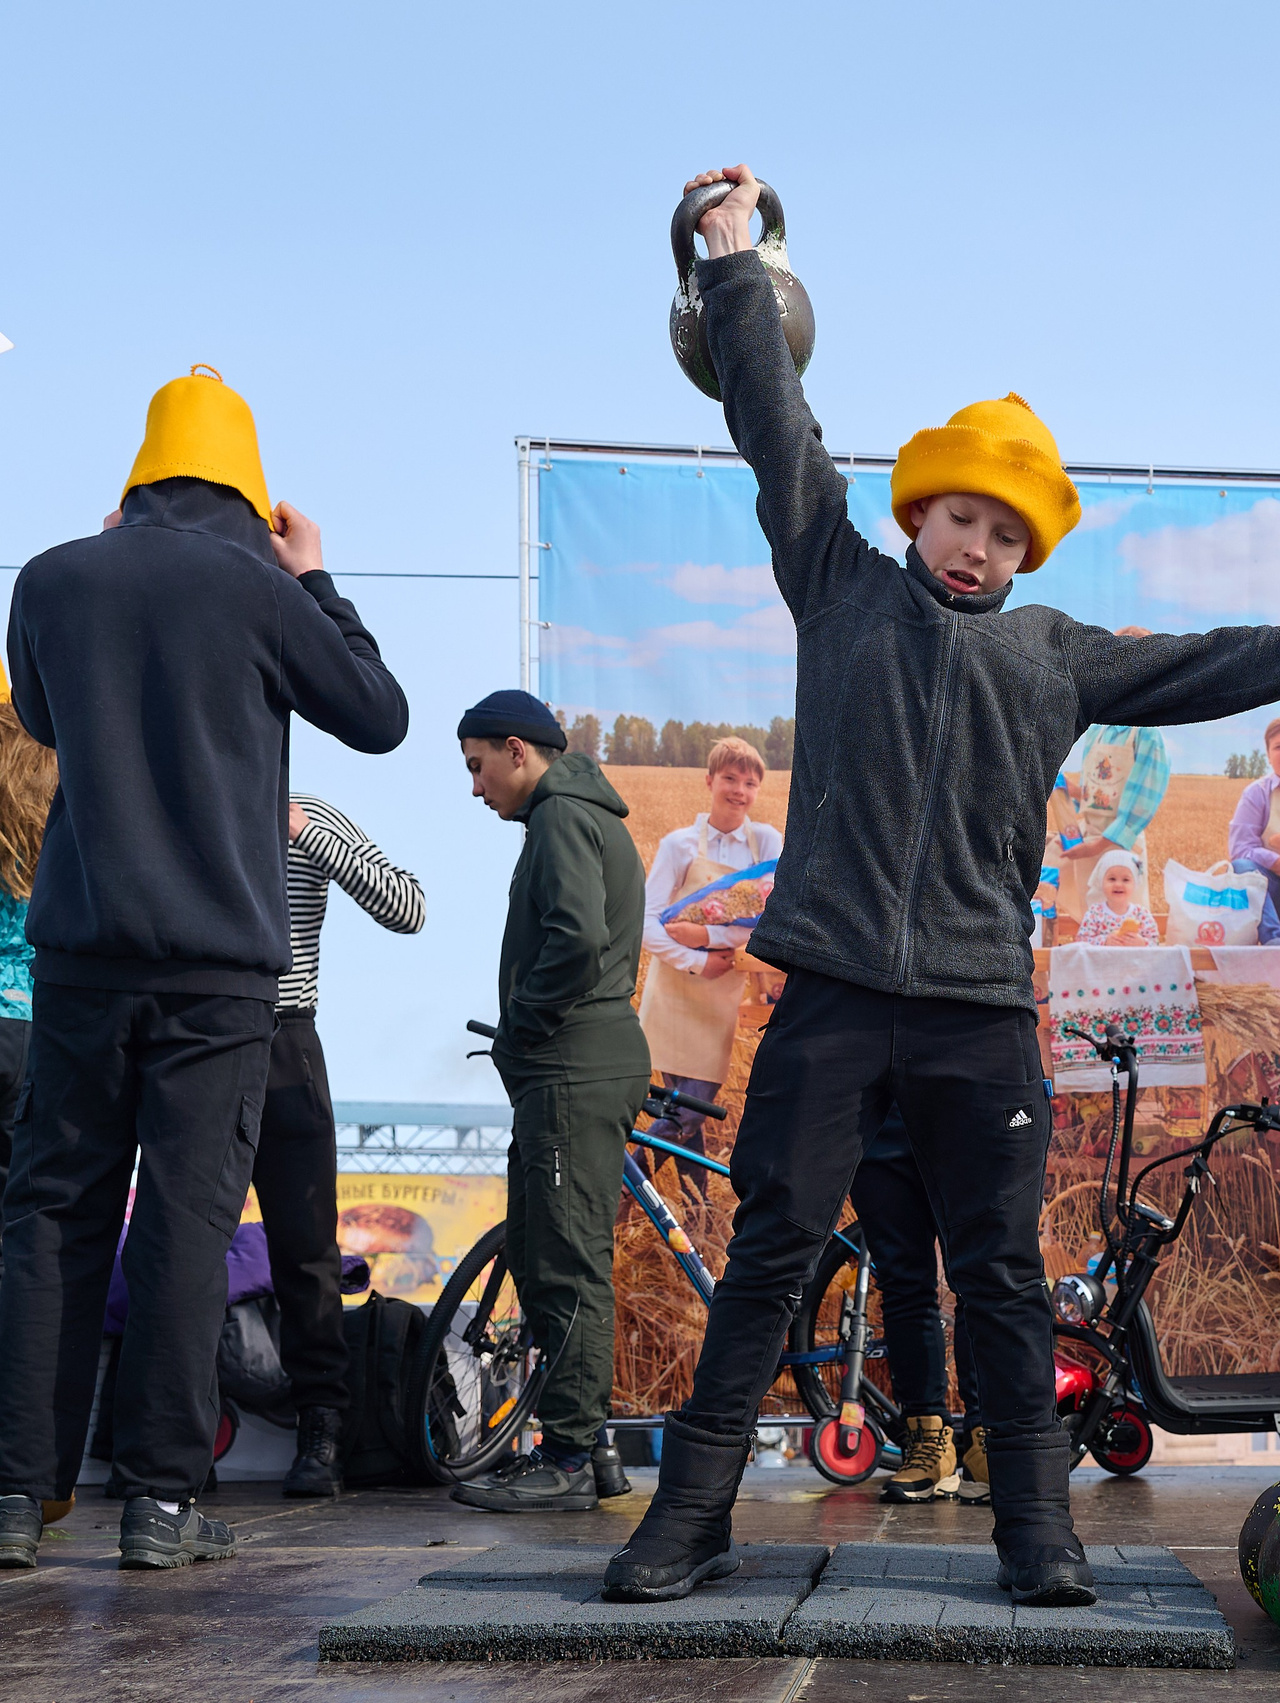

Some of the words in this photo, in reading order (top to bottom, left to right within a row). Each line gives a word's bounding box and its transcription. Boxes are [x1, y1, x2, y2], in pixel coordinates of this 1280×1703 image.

[1009, 1117, 1032, 1128] adidas
[336, 1183, 374, 1199] НЫЕ
[381, 1184, 457, 1205] БУРГЕРЫ
[637, 1179, 717, 1295] STLS
